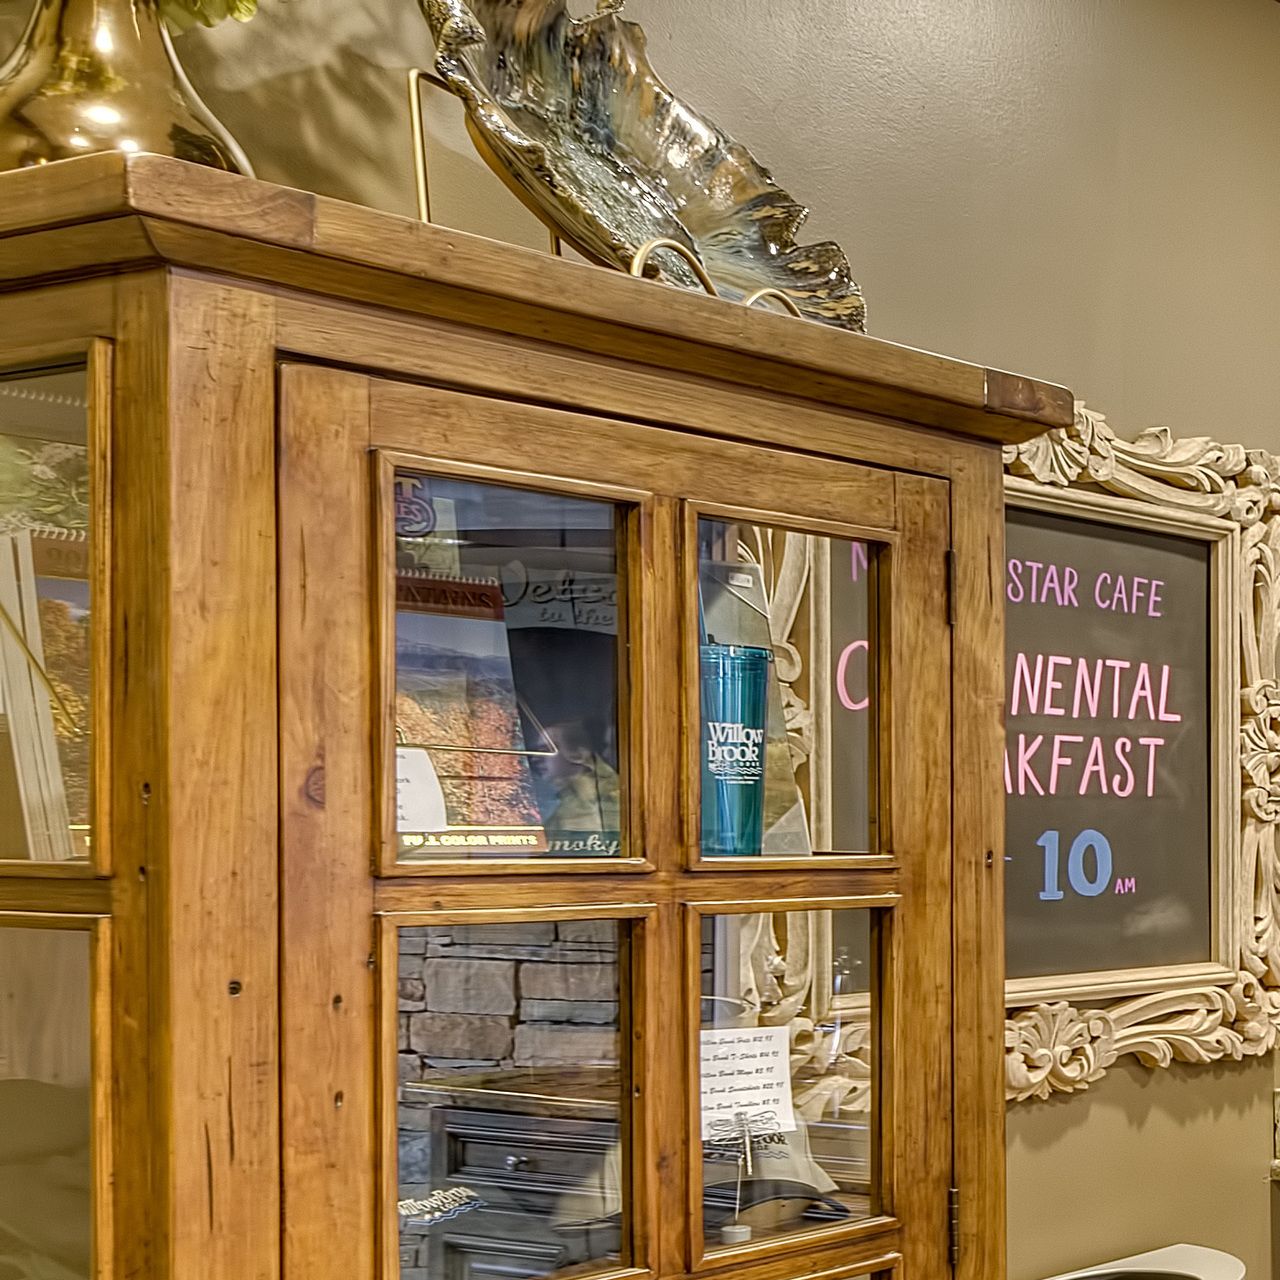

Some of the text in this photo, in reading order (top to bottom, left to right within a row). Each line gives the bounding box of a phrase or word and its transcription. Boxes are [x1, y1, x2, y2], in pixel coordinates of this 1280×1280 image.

[1007, 559, 1165, 617] STAR CAFE
[707, 721, 764, 743] Willow
[707, 739, 759, 762] Brook
[1036, 829, 1136, 901] 10 AM
